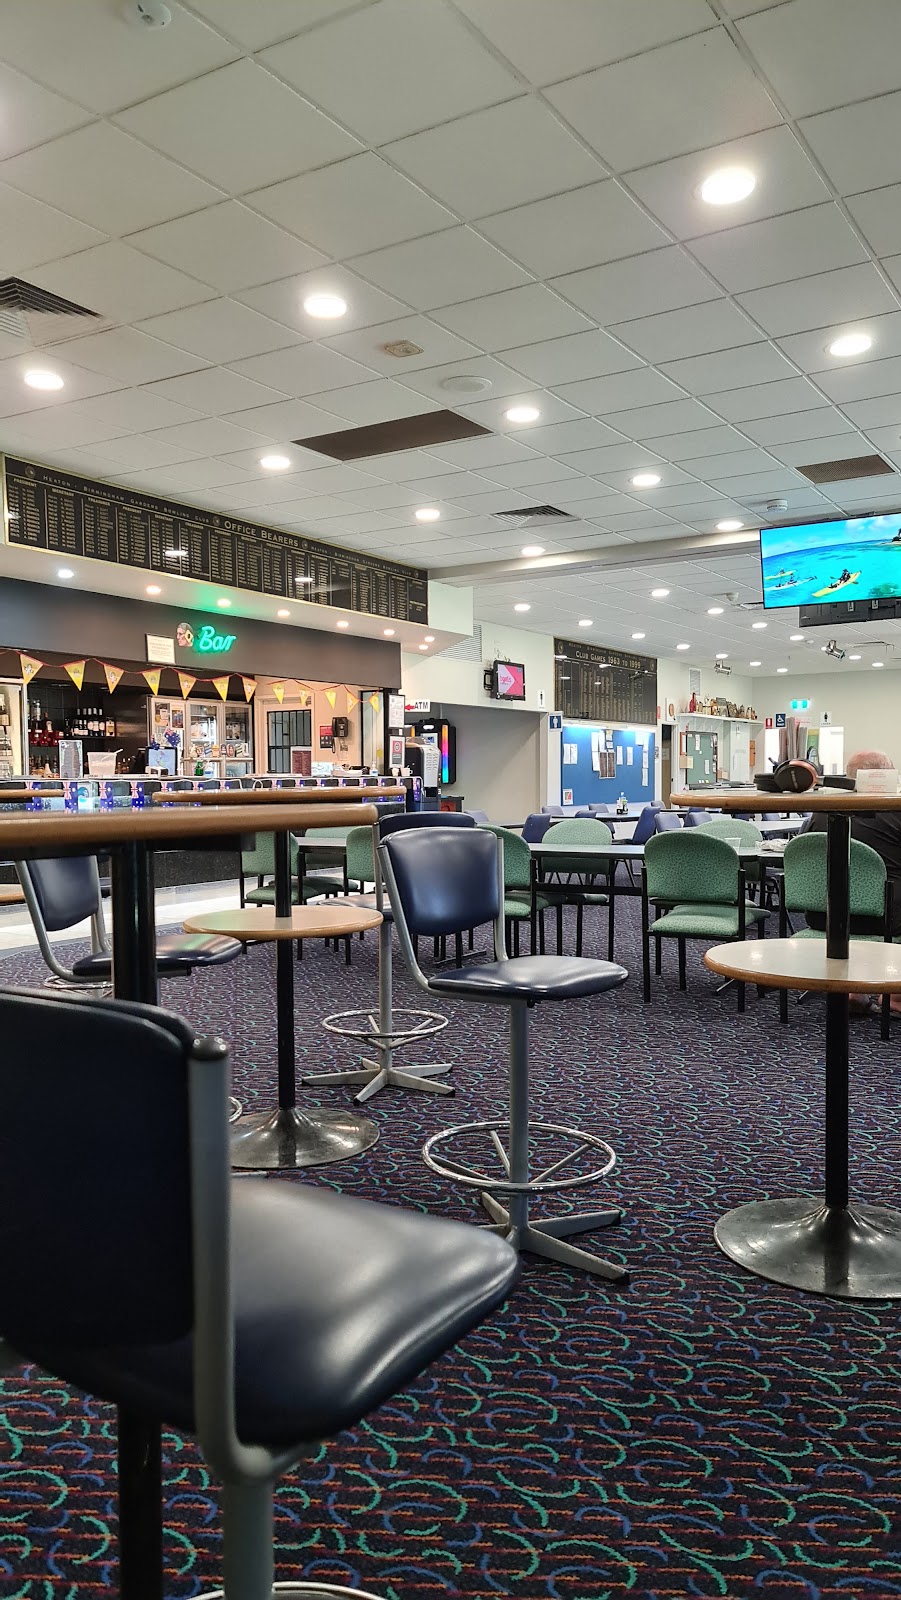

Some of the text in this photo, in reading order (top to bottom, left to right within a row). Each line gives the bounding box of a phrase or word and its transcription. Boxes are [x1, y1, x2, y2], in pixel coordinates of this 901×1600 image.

[43, 474, 71, 488] HEATON
[83, 485, 125, 501] BIRMINGHAM
[224, 520, 299, 548] OFFICE BEARERS
[198, 625, 237, 651] Bar
[575, 650, 589, 660] CLUB
[590, 653, 606, 663] GAMES
[607, 655, 621, 666] 1963
[414, 701, 429, 710] ATM
